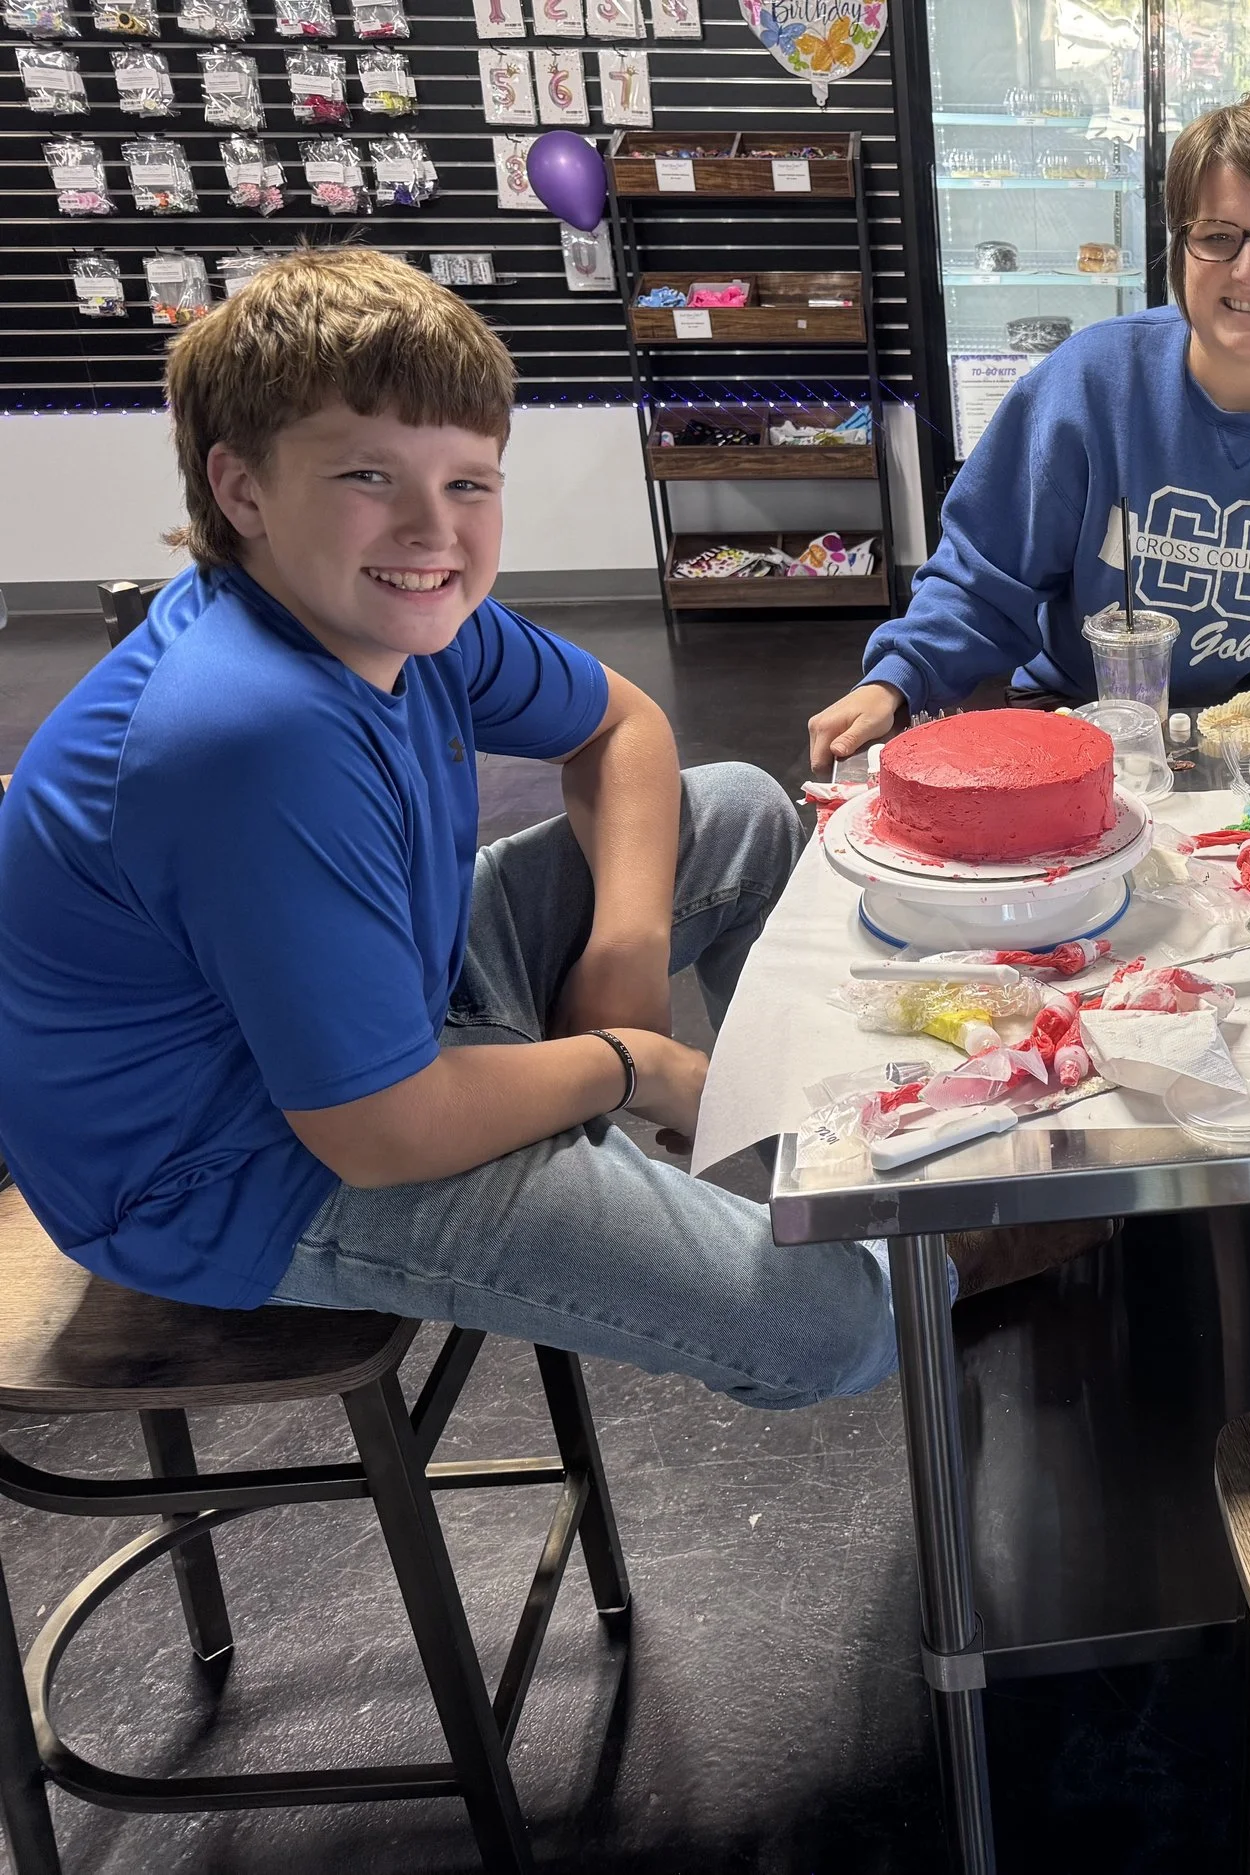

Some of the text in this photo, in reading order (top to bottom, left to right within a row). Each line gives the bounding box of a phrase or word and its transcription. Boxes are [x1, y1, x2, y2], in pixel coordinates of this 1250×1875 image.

[772, 0, 860, 37] Birthday
[549, 69, 573, 110] 6
[972, 368, 1016, 376] TO-GO KITS
[1135, 535, 1200, 563] CROSS
